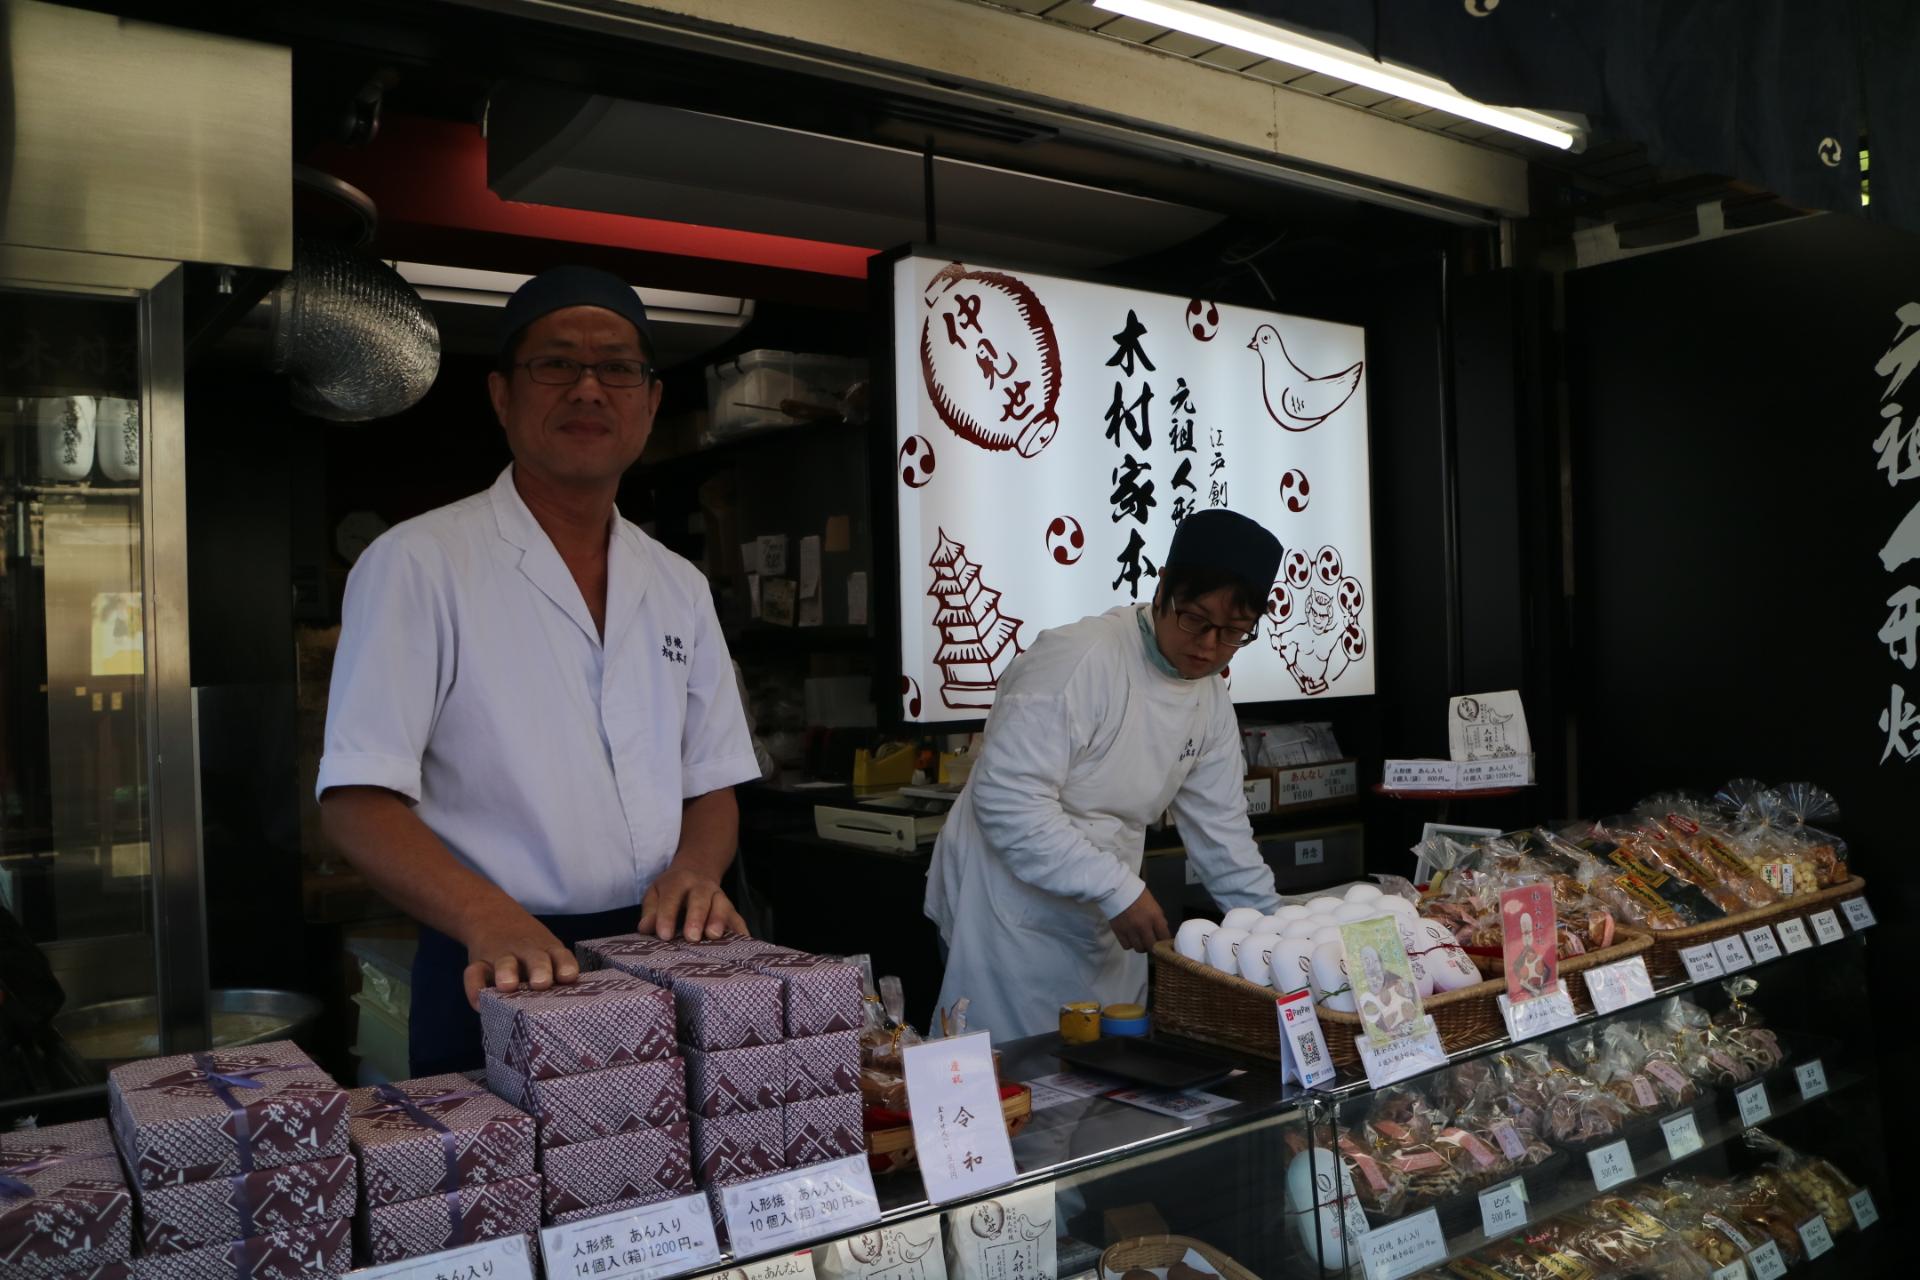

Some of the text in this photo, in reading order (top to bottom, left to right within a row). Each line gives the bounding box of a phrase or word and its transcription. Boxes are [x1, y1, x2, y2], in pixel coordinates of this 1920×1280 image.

[942, 294, 1035, 422] 仲見世
[1104, 309, 1158, 599] 木村家本
[1291, 769, 1324, 782] あんなし
[953, 1106, 983, 1172] 令和
[748, 1176, 844, 1215] 人形焼 あん入り
[573, 1218, 681, 1258] 人形焼 あん入り
[764, 1260, 806, 1280] あんなし
